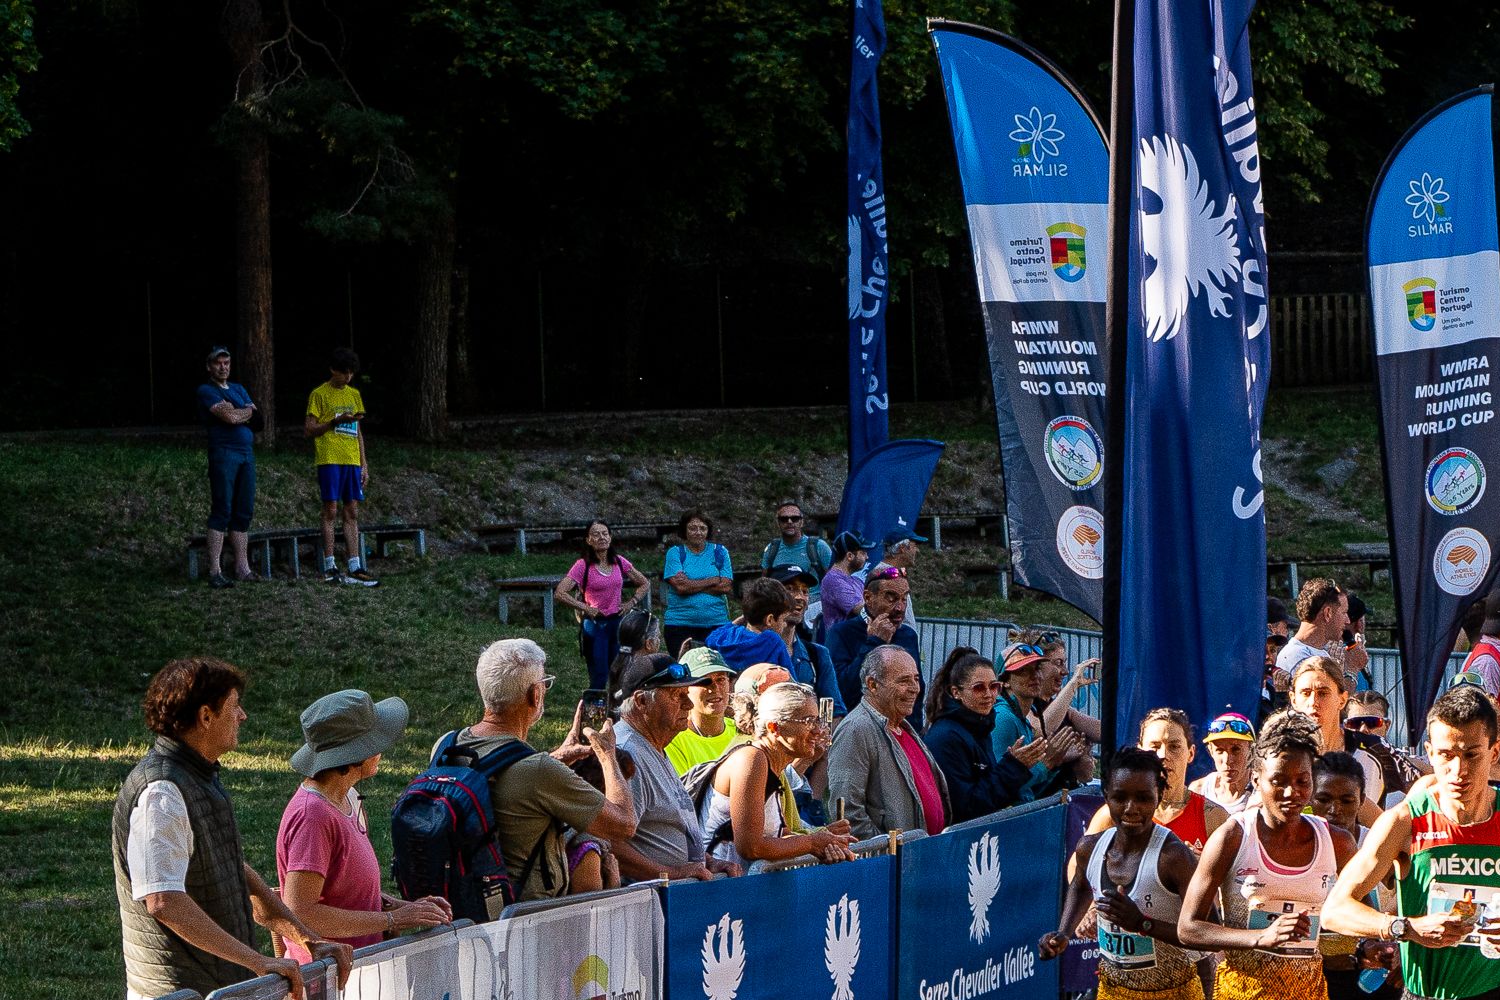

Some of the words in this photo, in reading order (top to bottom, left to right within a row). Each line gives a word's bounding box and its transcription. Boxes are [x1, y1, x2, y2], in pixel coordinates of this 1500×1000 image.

[1408, 222, 1454, 238] SILMAR
[1438, 286, 1470, 296] Turismo
[1440, 294, 1466, 304] Centro
[1440, 302, 1473, 313] Portugal
[1440, 355, 1490, 377] WMRA
[1414, 373, 1490, 399] MOUNTAIN
[1426, 392, 1492, 416] RUNNING
[1407, 416, 1456, 438] WORLD
[1461, 410, 1495, 427] CUP
[1105, 931, 1135, 956] 370
[1004, 944, 1035, 984] Vallée
